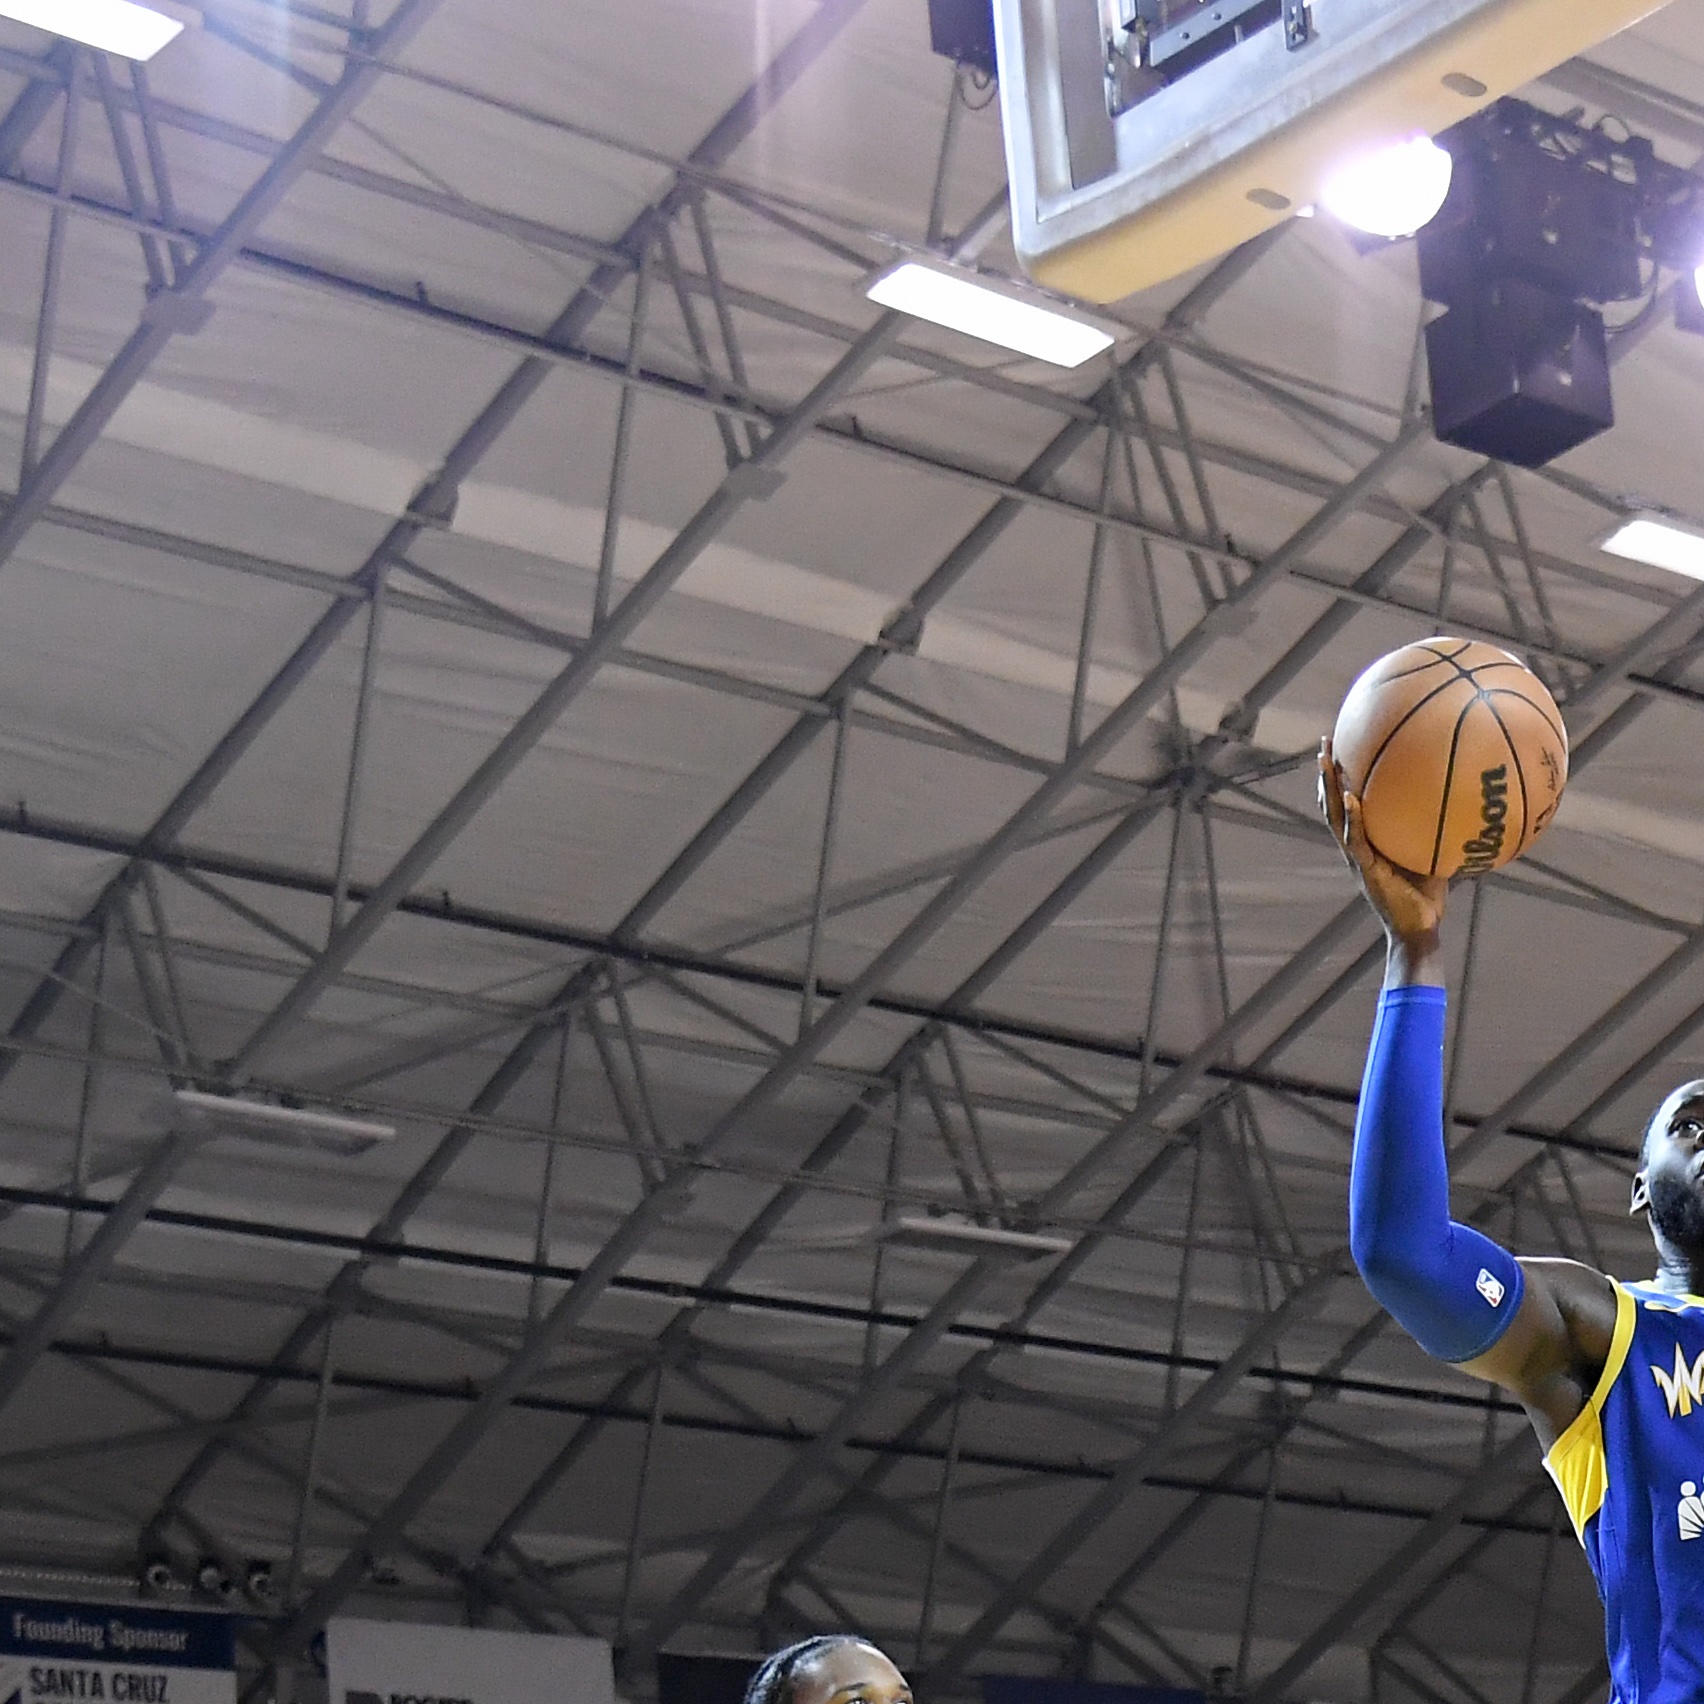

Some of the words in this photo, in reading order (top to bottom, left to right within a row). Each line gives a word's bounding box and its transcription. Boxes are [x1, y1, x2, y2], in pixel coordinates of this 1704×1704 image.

[13, 1612, 104, 1649] Founding
[109, 1619, 188, 1650] Sponsor
[30, 1667, 104, 1698] SANTA
[112, 1672, 169, 1703] CRUZ
